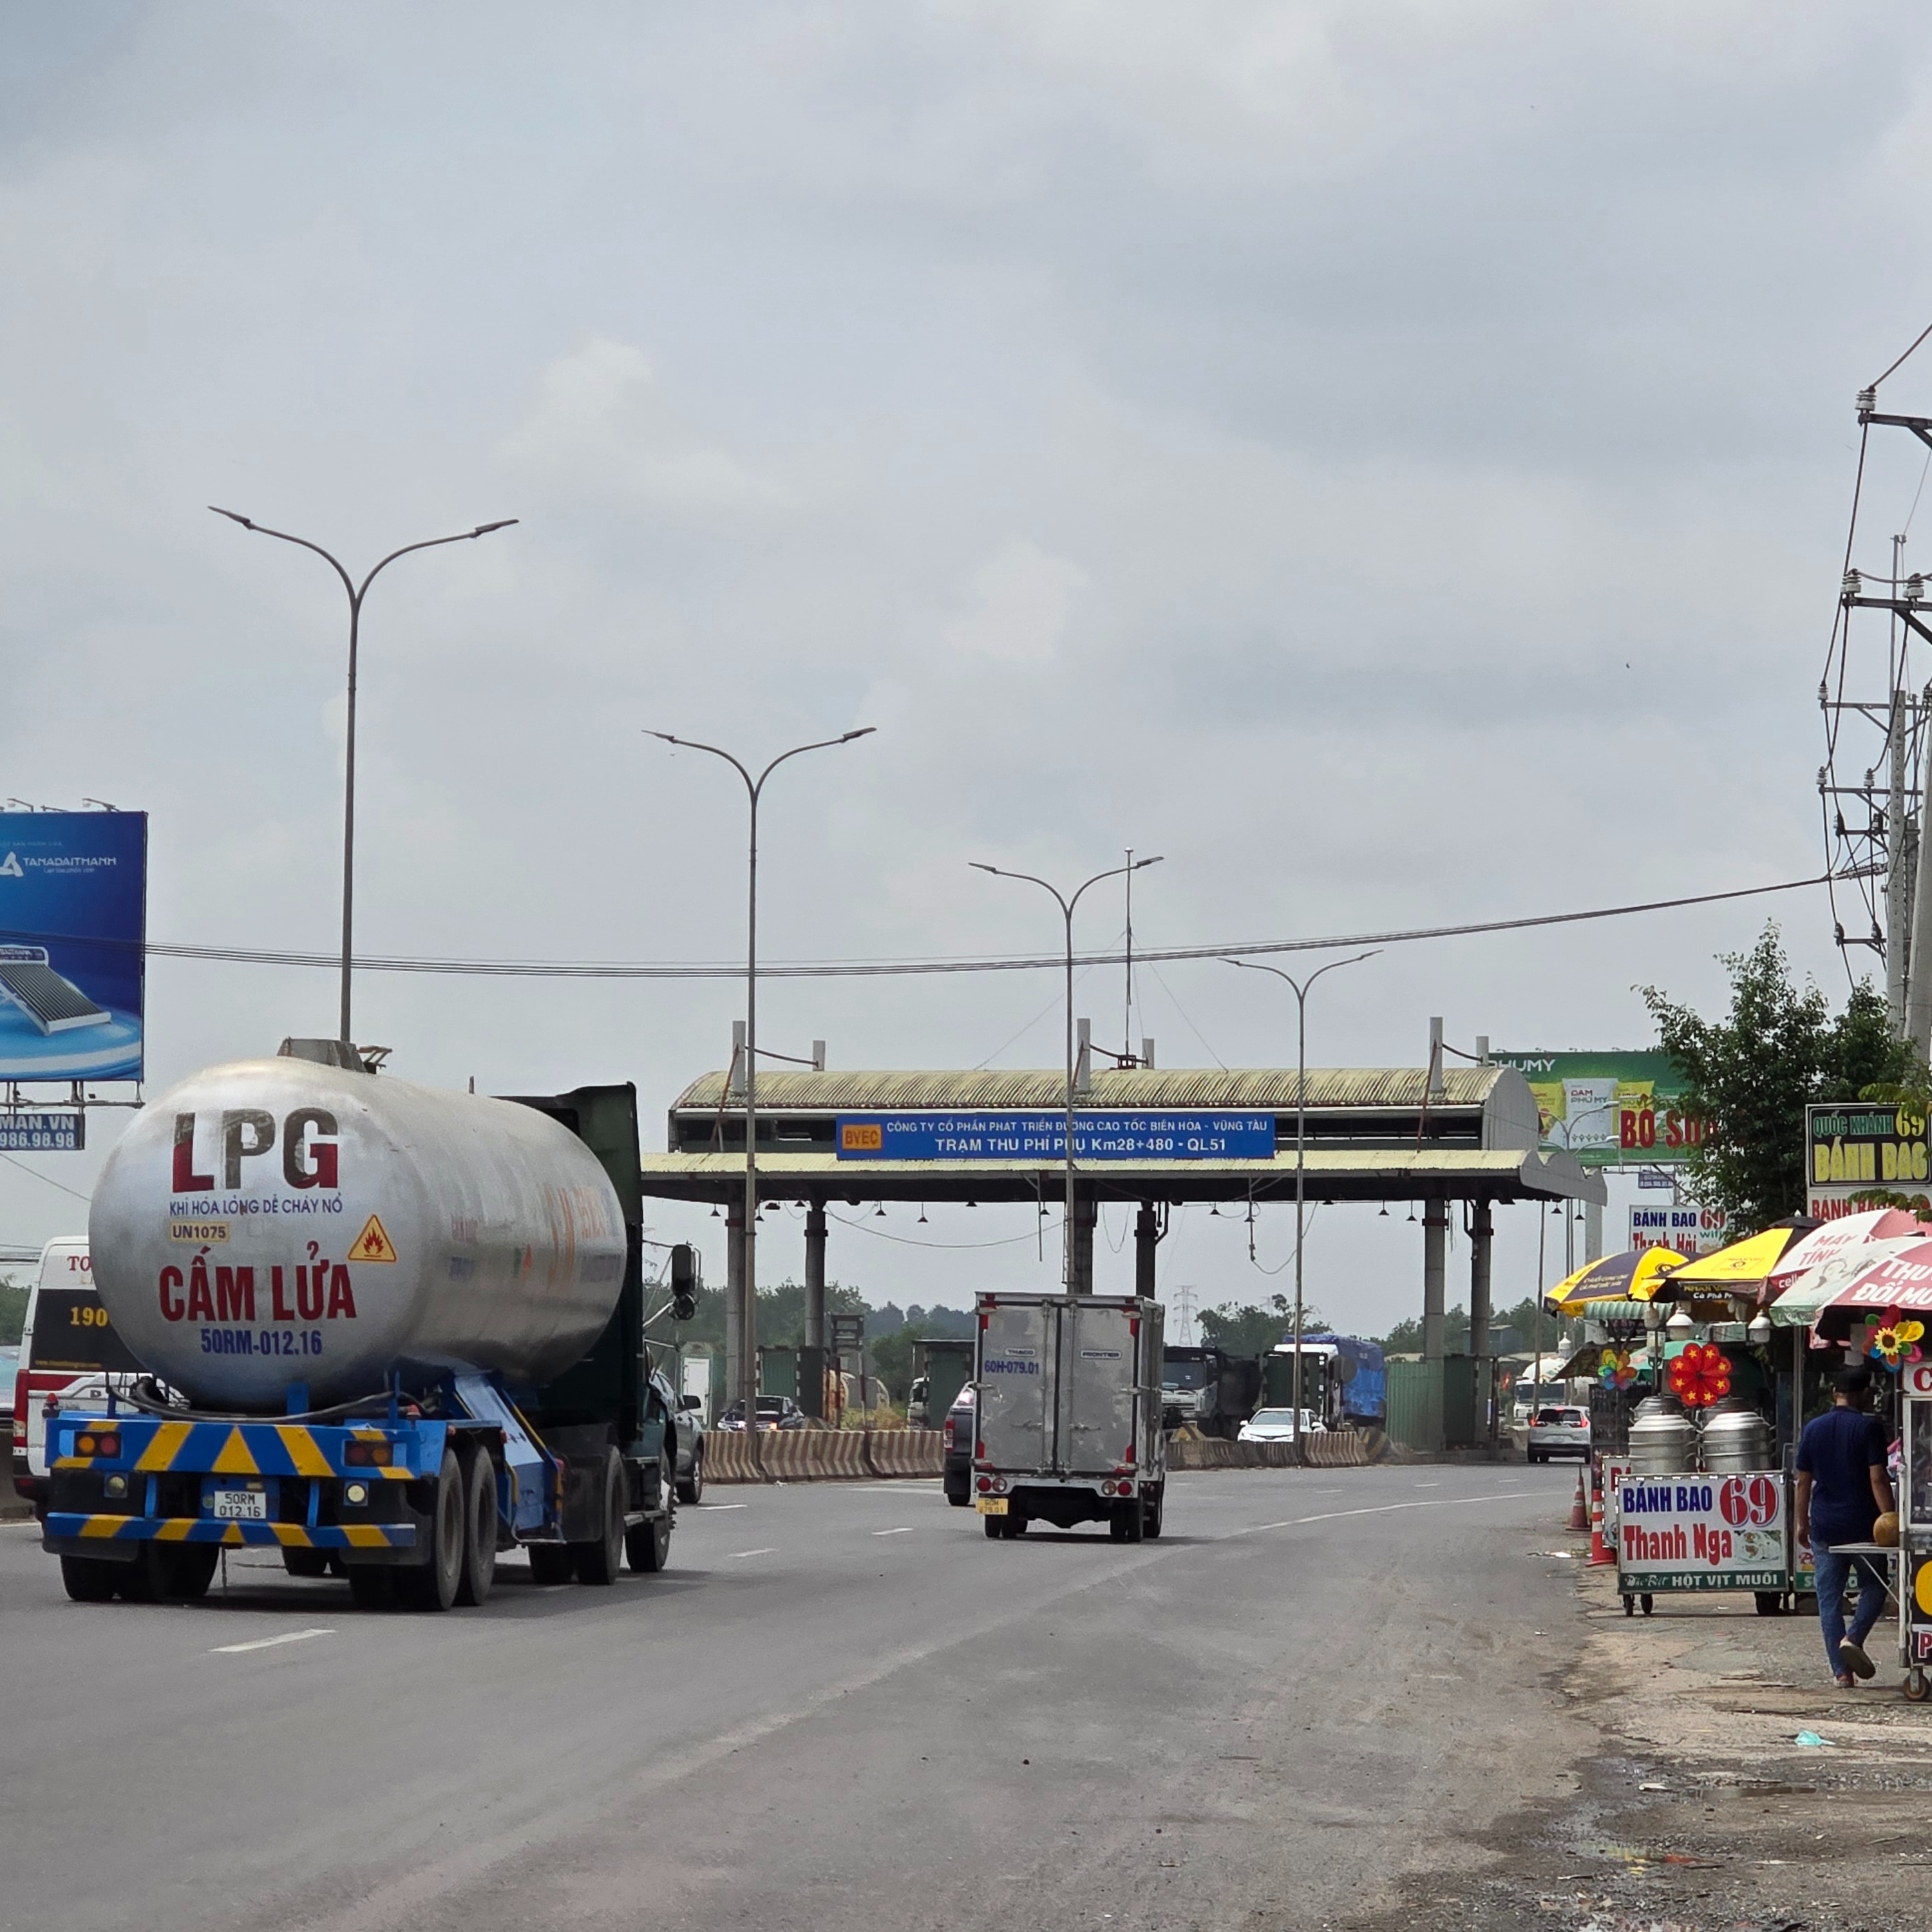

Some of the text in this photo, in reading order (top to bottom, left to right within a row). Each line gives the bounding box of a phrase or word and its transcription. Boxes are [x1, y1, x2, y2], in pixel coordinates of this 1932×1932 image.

[887, 1121, 917, 1132] CÔNG
[920, 1122, 934, 1132] TY
[1097, 1121, 1120, 1131] CAO
[1123, 1118, 1146, 1131] TỐC
[1213, 1120, 1244, 1132] VŨNG
[1246, 1119, 1267, 1131] TÀU
[1814, 1107, 1926, 1138] QUỐC KHÁNH 69
[172, 1107, 338, 1193] LPG
[934, 1138, 981, 1153] TRẠM
[987, 1138, 1019, 1151] THU
[1024, 1134, 1050, 1151] PHÍ
[1092, 1138, 1173, 1151] Km28+480
[1188, 1138, 1226, 1151] QL51
[1814, 1135, 1927, 1182] BÁNH BAO
[170, 1197, 189, 1216] KHÍ
[192, 1197, 220, 1215] HÓA
[223, 1195, 259, 1216] LỎNG
[263, 1194, 278, 1213] DỄ
[281, 1195, 319, 1213] CHÁY
[1633, 1208, 1725, 1230] BÁNH BAO 69
[173, 1225, 226, 1238] UN1075
[160, 1241, 357, 1321] CẤM LỬA
[70, 1307, 108, 1326] 190
[201, 1329, 322, 1355] 50RM-012.16
[985, 1360, 1039, 1374] 60H-079.01
[225, 1493, 255, 1504] 50RM
[1623, 1477, 1779, 1528] BÁNH BAO 69
[220, 1506, 261, 1517] 012.16
[1624, 1523, 1732, 1566] Thanh Nga
[1672, 1574, 1702, 1590] HỘT
[1707, 1575, 1730, 1587] VỊT
[1736, 1571, 1777, 1585] MUỐI
